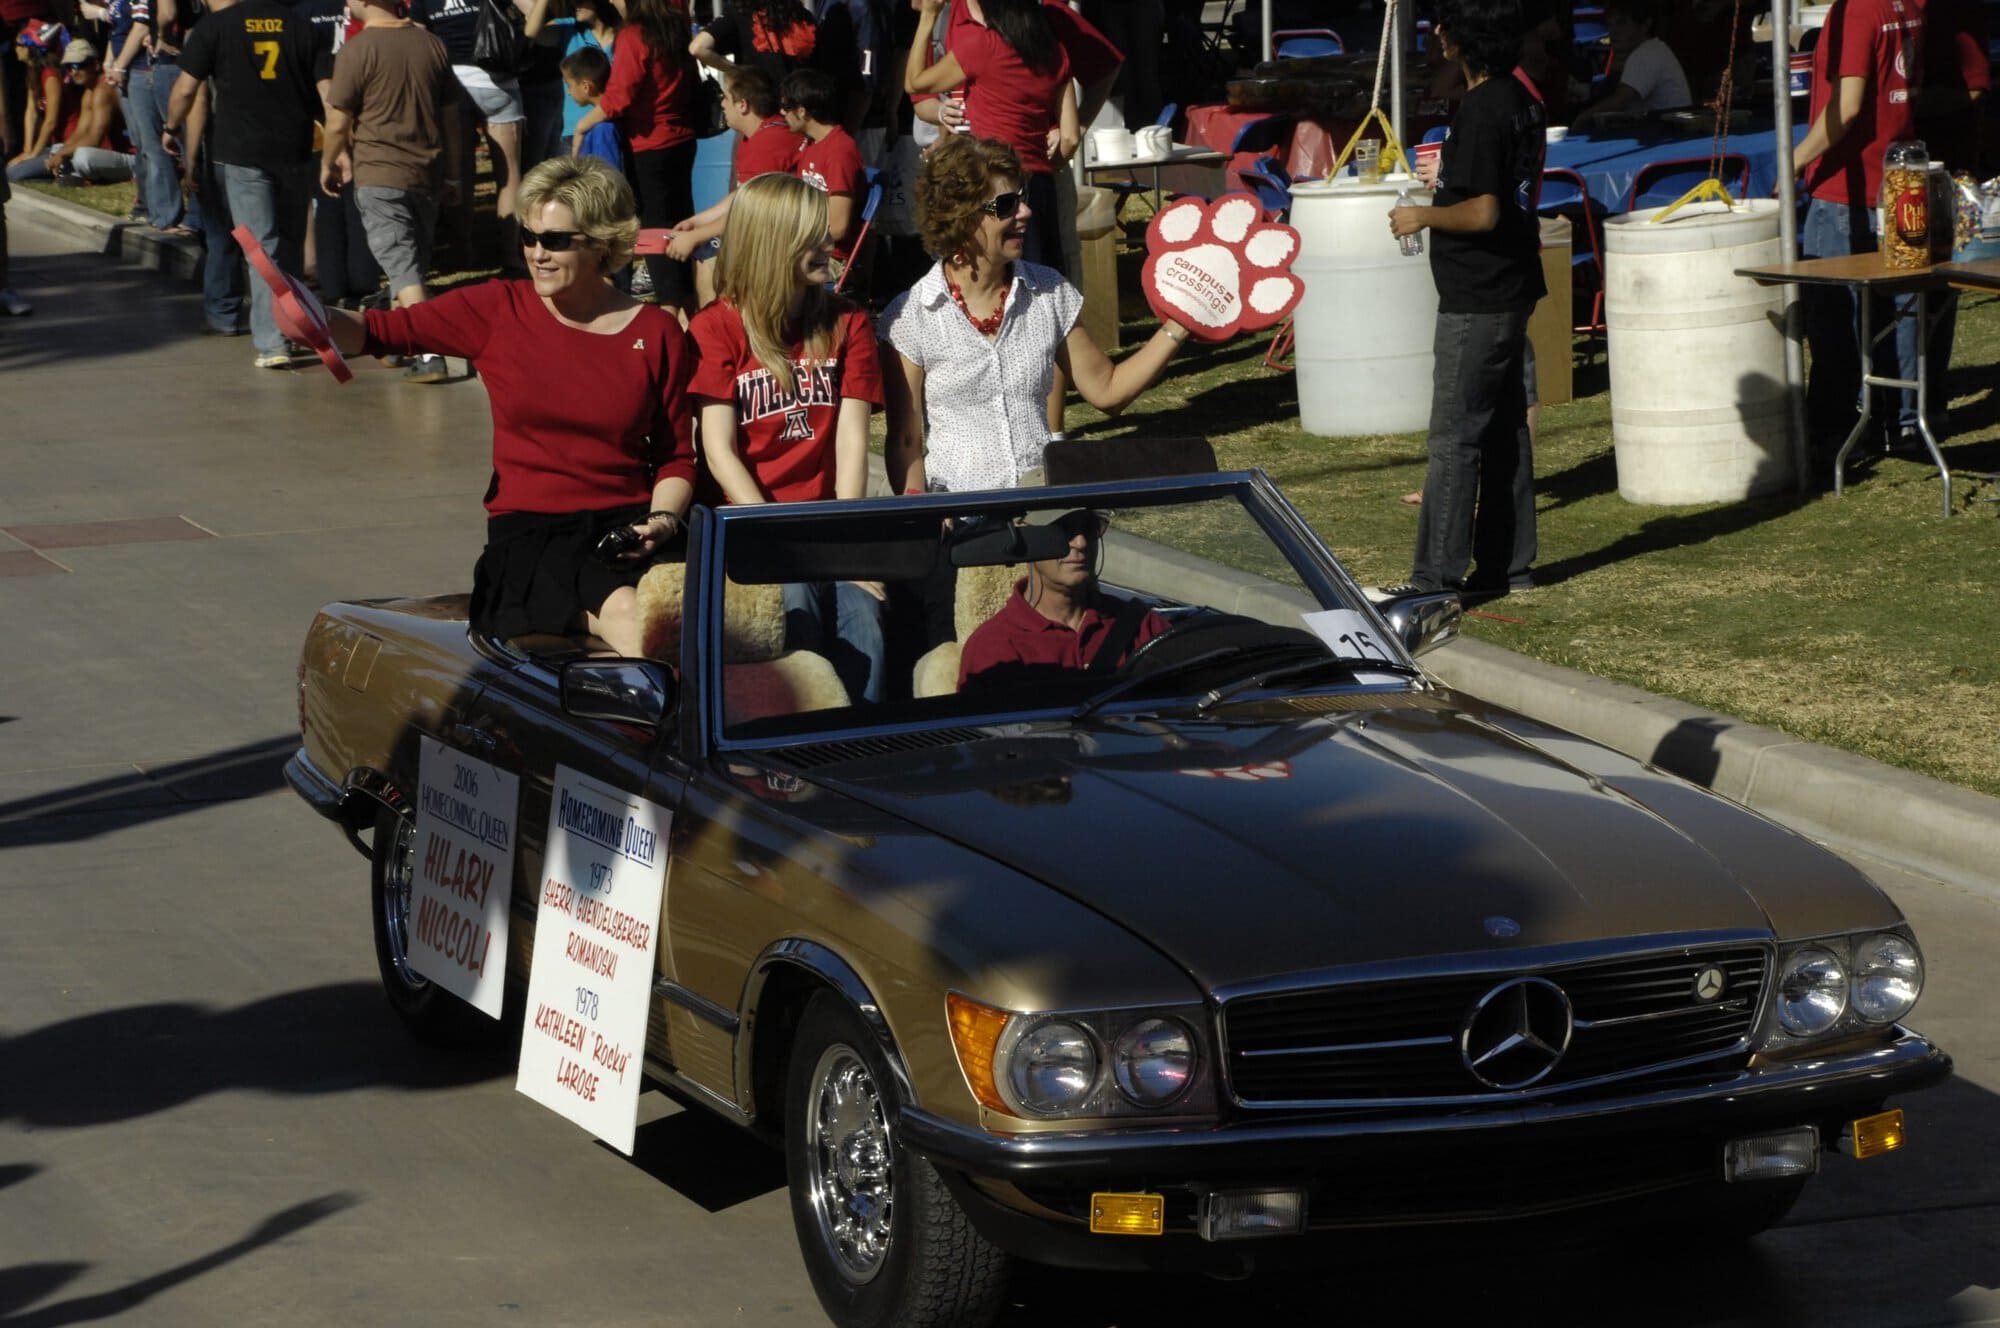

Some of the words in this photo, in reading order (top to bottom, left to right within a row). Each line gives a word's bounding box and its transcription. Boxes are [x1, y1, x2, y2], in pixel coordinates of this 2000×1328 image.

[254, 41, 280, 80] 7
[1165, 266, 1228, 314] crossings
[1174, 256, 1226, 295] campus
[780, 408, 816, 441] A
[453, 763, 479, 798] 2006
[421, 783, 478, 832] HOMECOMING
[479, 811, 510, 846] QUEEN
[558, 788, 625, 849] HOMECOMING
[624, 816, 657, 863] QUEEN
[424, 832, 494, 911] HILARY
[589, 861, 614, 895] 1973
[543, 879, 576, 917] SHERRI
[416, 895, 492, 979] NICCOLI
[565, 930, 619, 981] ROMANOSKI
[575, 986, 600, 1021] 1978
[534, 1002, 587, 1053] KATHLEEN
[556, 1055, 600, 1102] LAROSE
